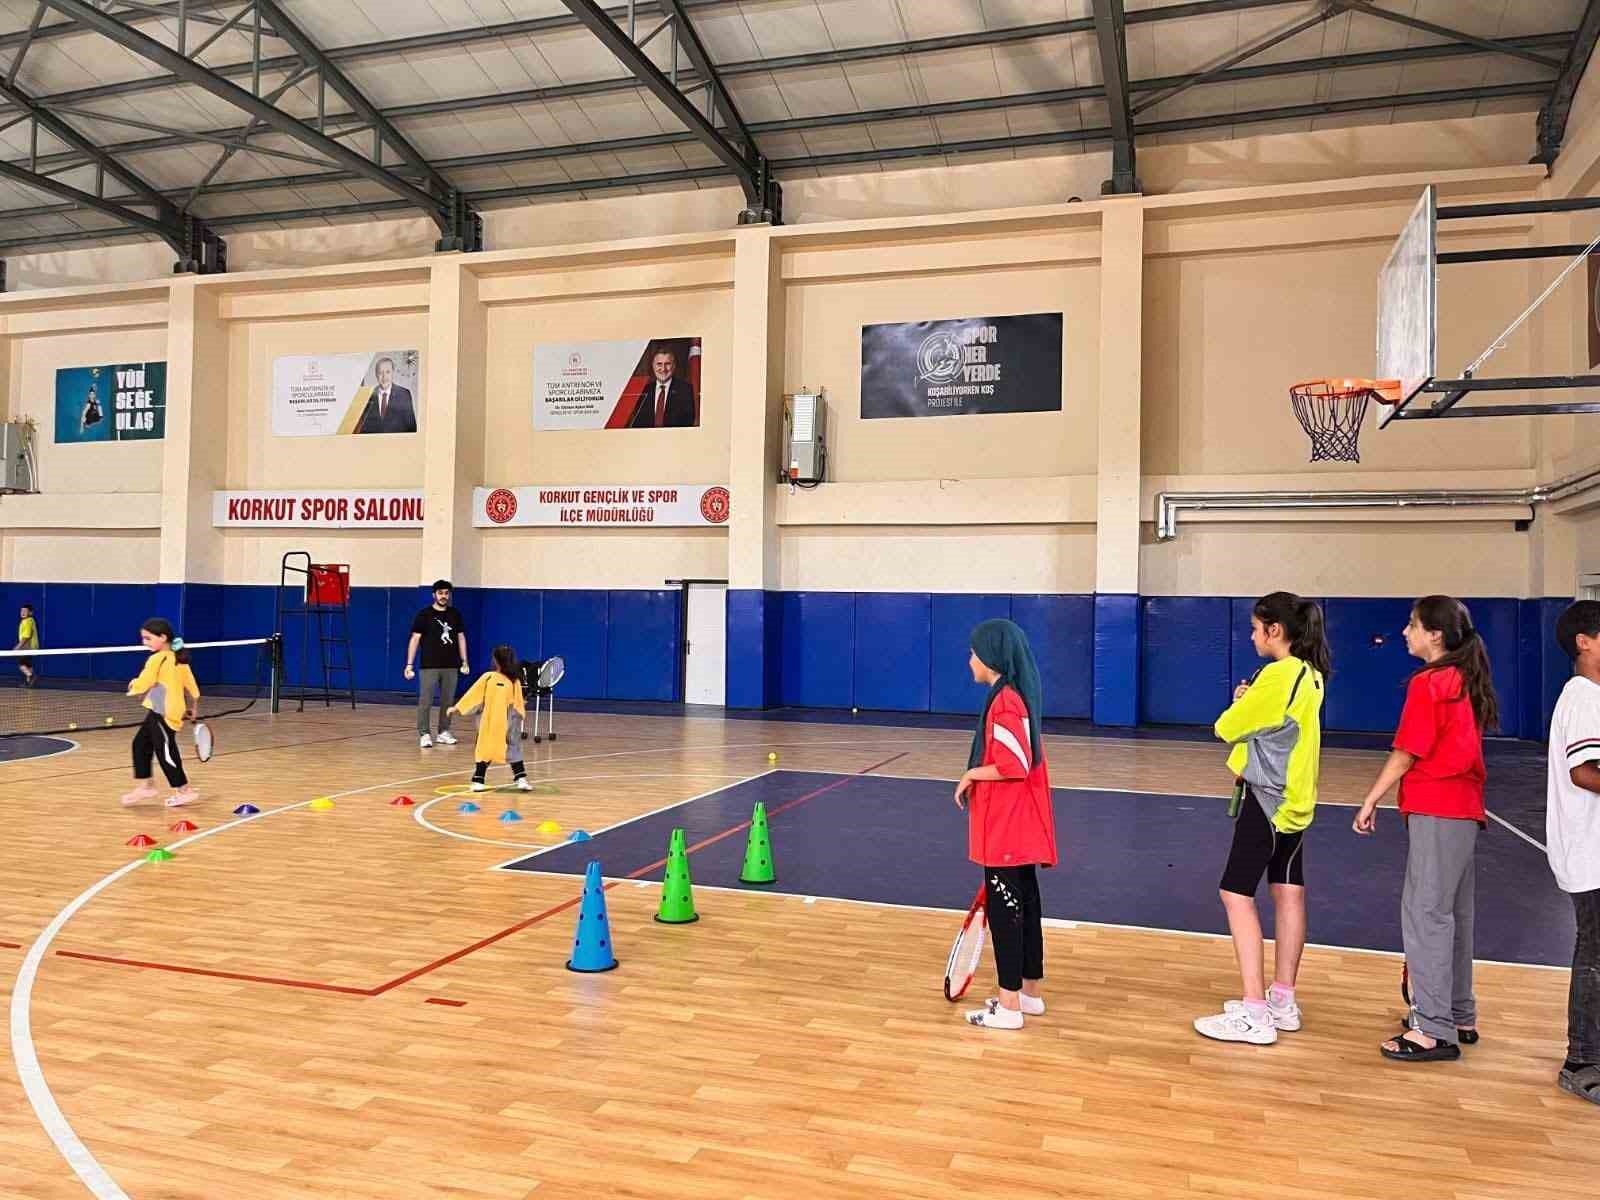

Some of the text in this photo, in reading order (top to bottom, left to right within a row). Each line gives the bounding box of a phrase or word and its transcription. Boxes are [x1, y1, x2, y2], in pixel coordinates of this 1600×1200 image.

[963, 326, 997, 344] SPOR
[116, 411, 154, 431] ULAŞ
[540, 488, 678, 505] KORKUT GENÇLİK VE SPOR
[228, 497, 424, 521] KORKUT SPOR SALONU
[560, 506, 654, 522] İLÇE MÜDÜRLÜĞÜ
